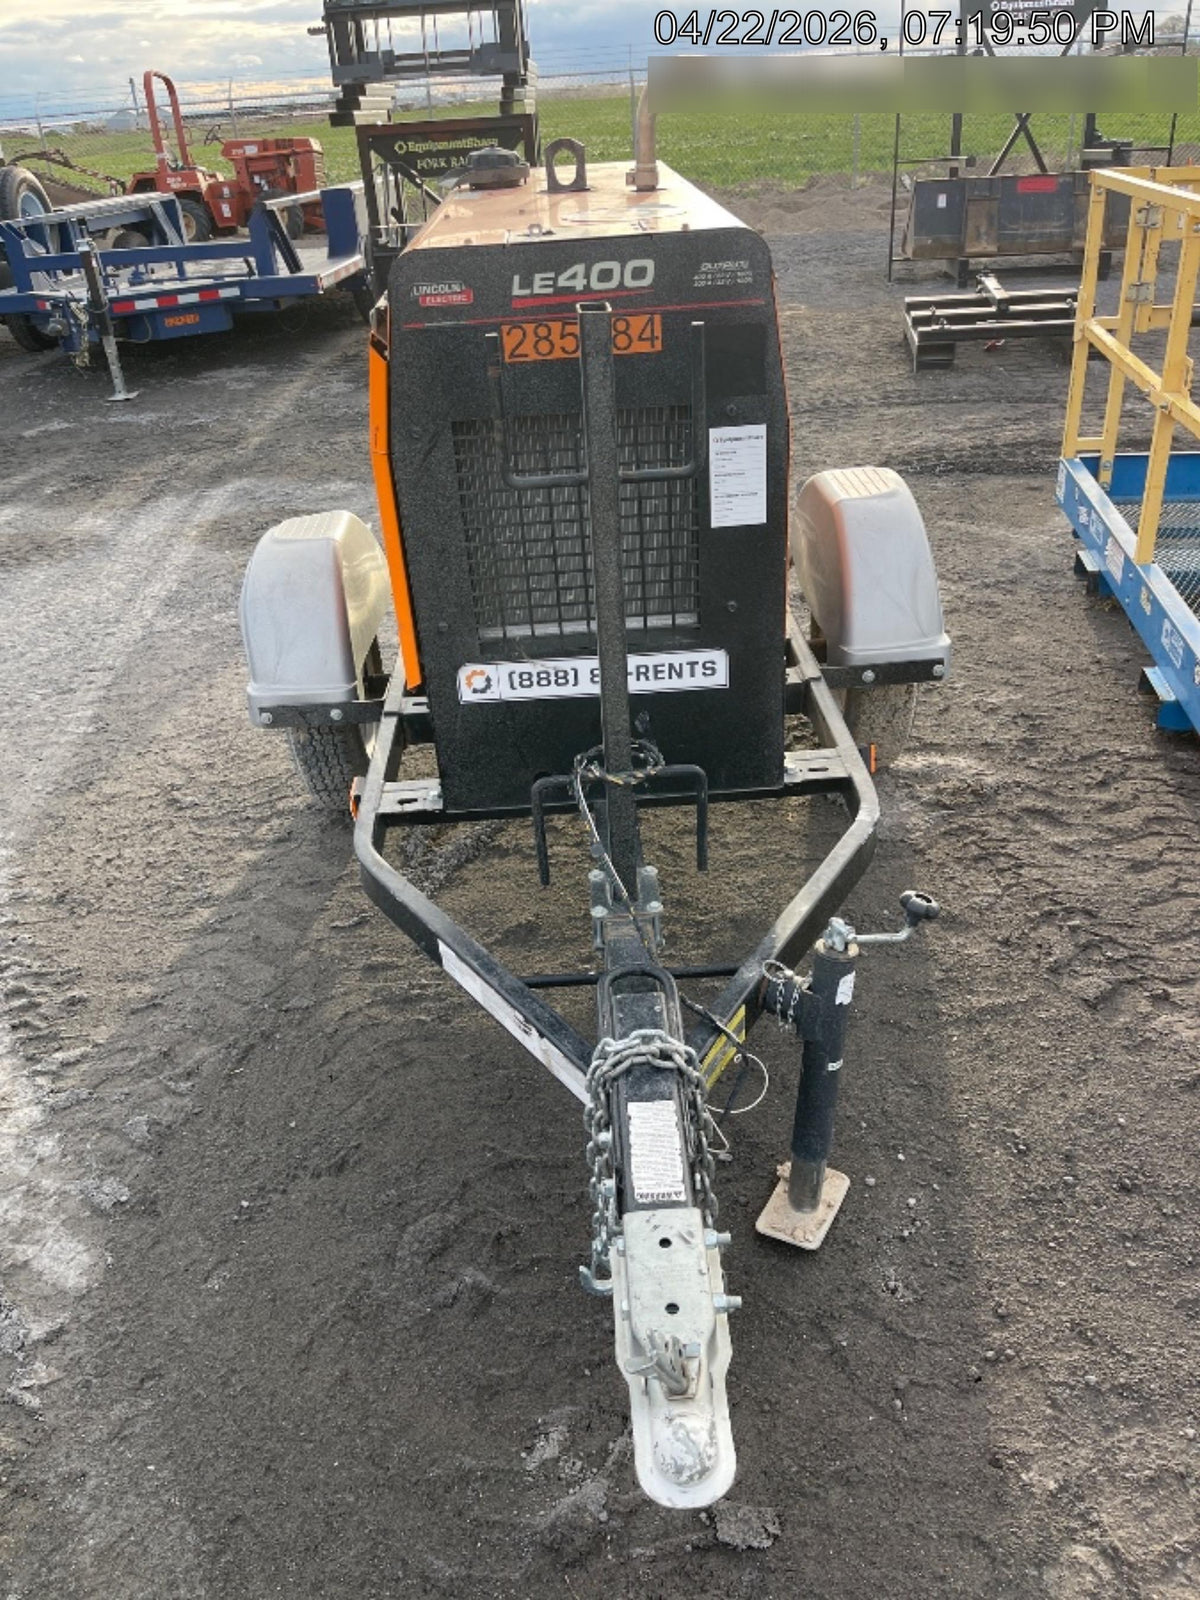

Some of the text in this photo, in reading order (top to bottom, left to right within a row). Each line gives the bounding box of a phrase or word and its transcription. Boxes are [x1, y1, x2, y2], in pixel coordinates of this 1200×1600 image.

[512, 259, 655, 296] LE400
[413, 283, 461, 296] LINCOLN
[426, 294, 468, 304] ELECTRIC
[507, 314, 659, 359] 28584
[508, 667, 579, 690] (888)
